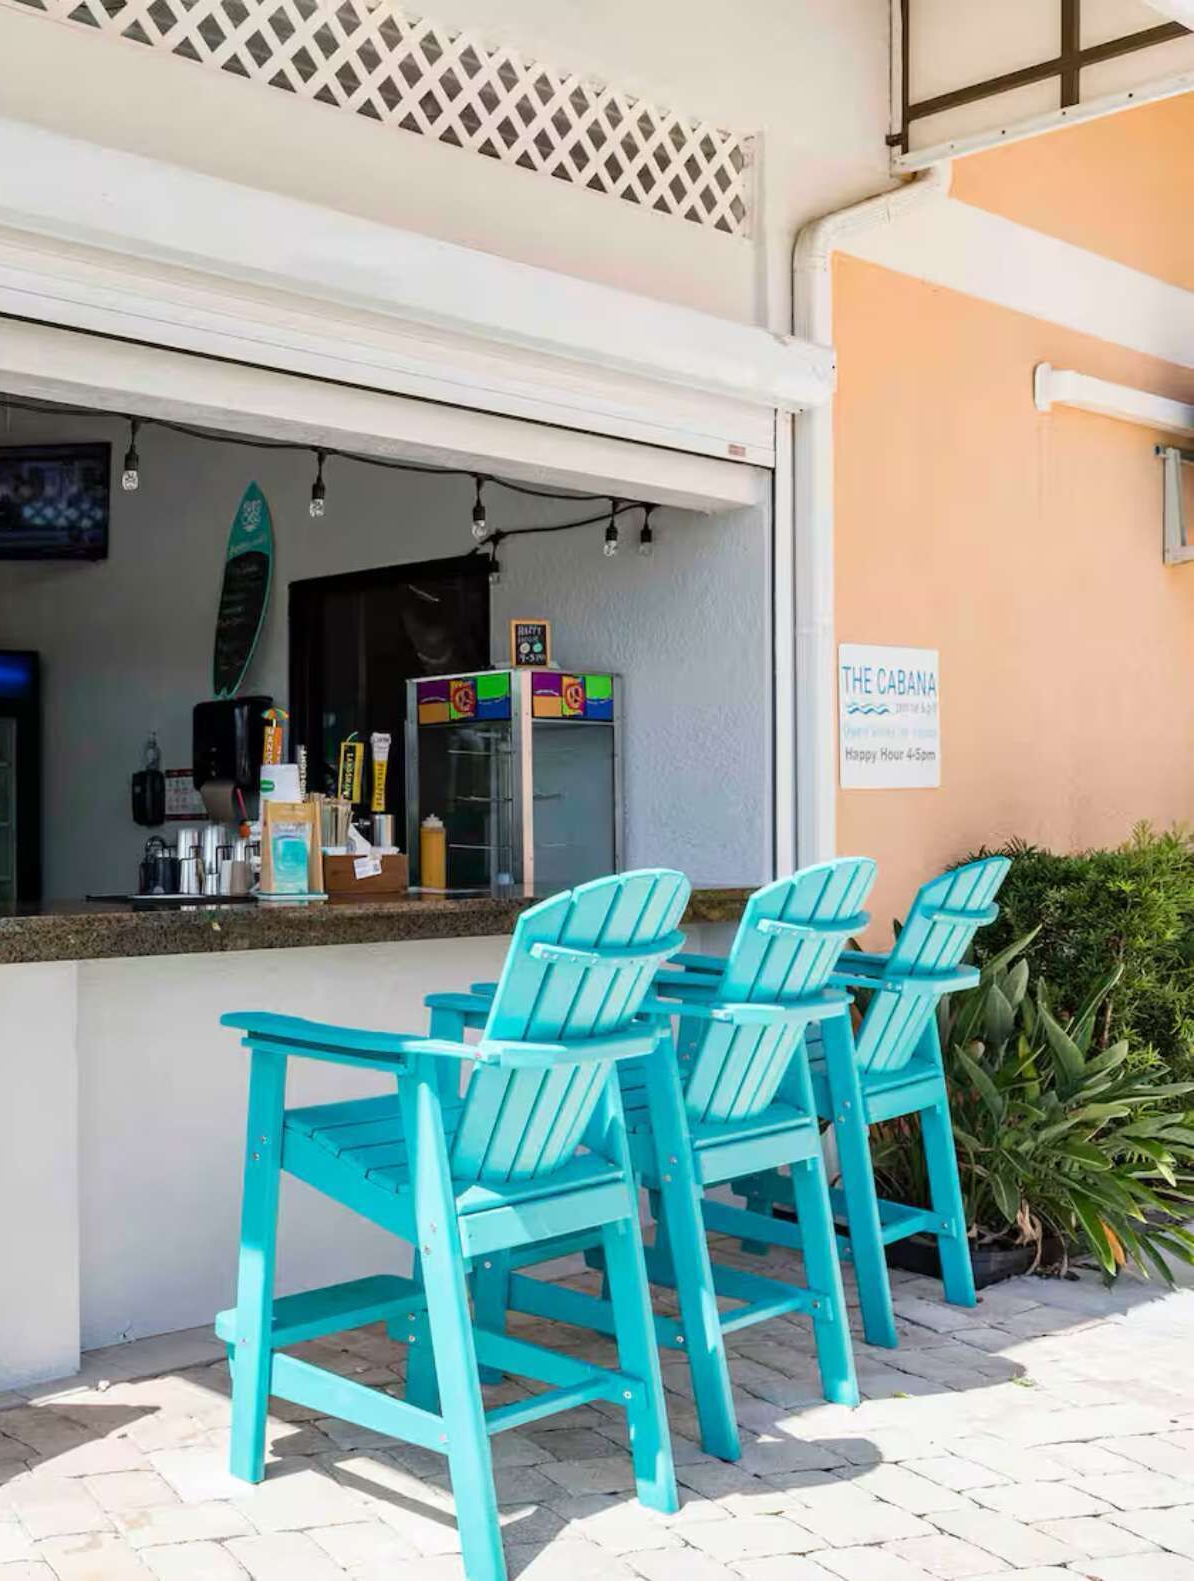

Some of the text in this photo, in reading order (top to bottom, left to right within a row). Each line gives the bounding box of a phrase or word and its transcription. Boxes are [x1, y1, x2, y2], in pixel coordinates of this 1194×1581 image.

[842, 665, 937, 697] THE CABANA
[845, 746, 936, 763] Happy Hour 4-5pm
